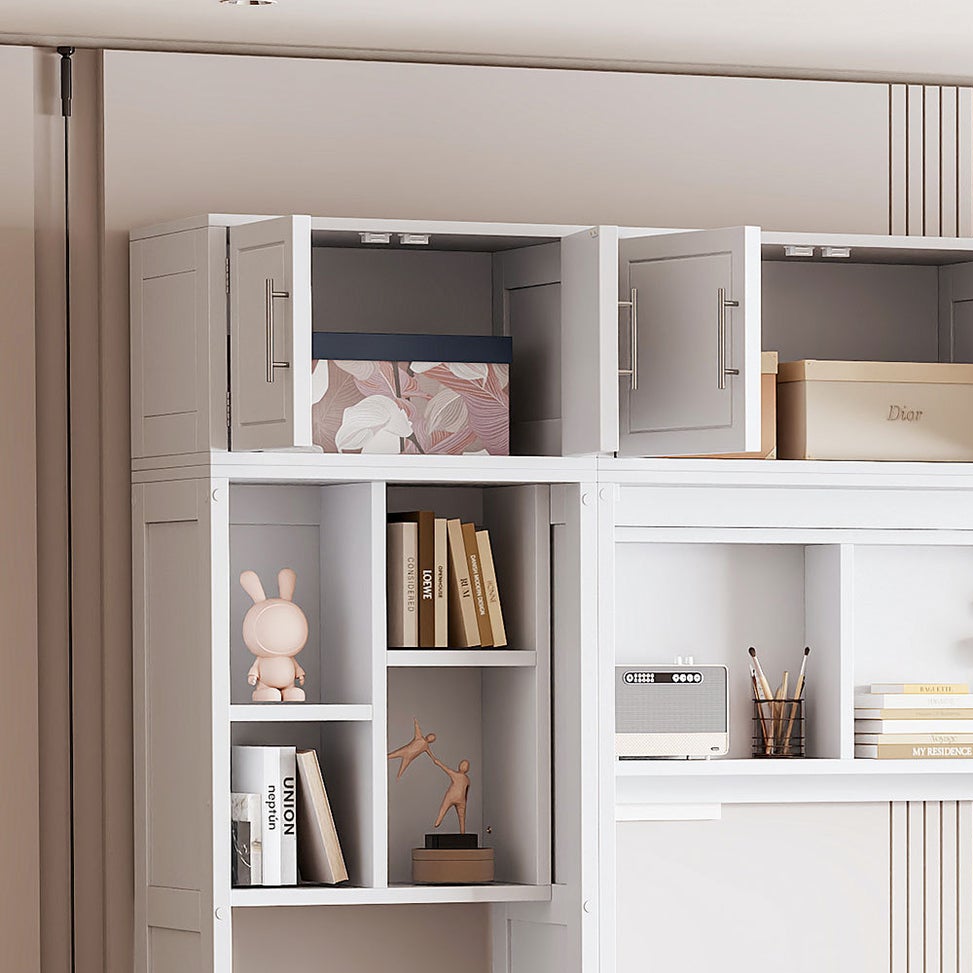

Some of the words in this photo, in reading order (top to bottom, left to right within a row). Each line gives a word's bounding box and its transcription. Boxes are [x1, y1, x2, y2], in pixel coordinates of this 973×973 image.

[887, 404, 924, 422] Dior
[470, 554, 479, 574] DANISH
[407, 556, 416, 612] CONSIDERED
[422, 569, 433, 600] LOEWE
[474, 574, 482, 597] MODERN
[477, 596, 486, 616] DESIGN
[912, 747, 927, 756] MY
[927, 746, 973, 756] RESIDENCE
[264, 785, 279, 831] neptún
[283, 776, 295, 836] UNION
